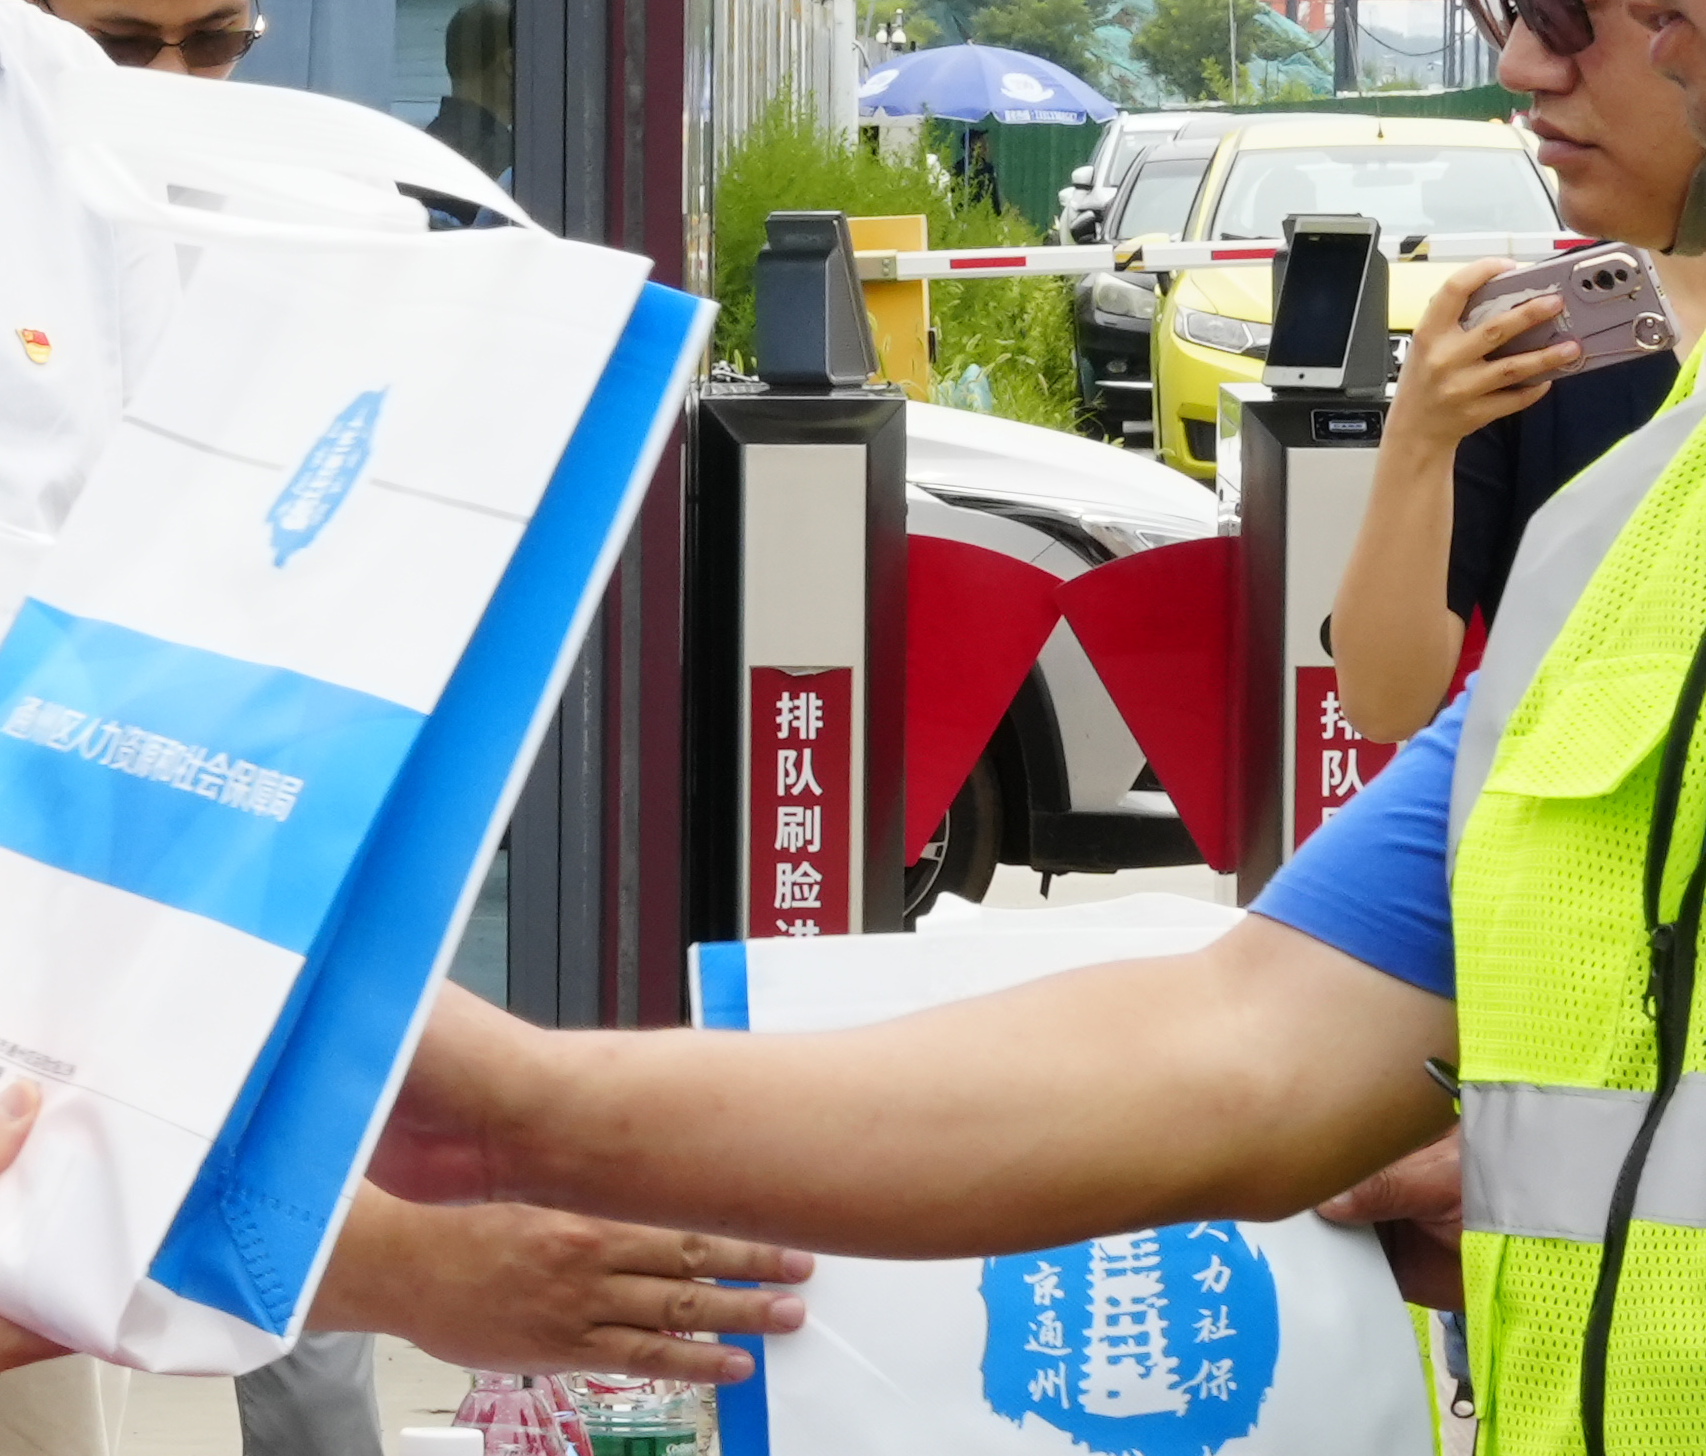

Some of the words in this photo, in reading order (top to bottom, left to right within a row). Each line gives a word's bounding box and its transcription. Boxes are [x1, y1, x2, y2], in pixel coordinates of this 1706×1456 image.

[0, 696, 305, 822] 通州区人力资源和社会保障局
[1320, 691, 1364, 825] 排队
